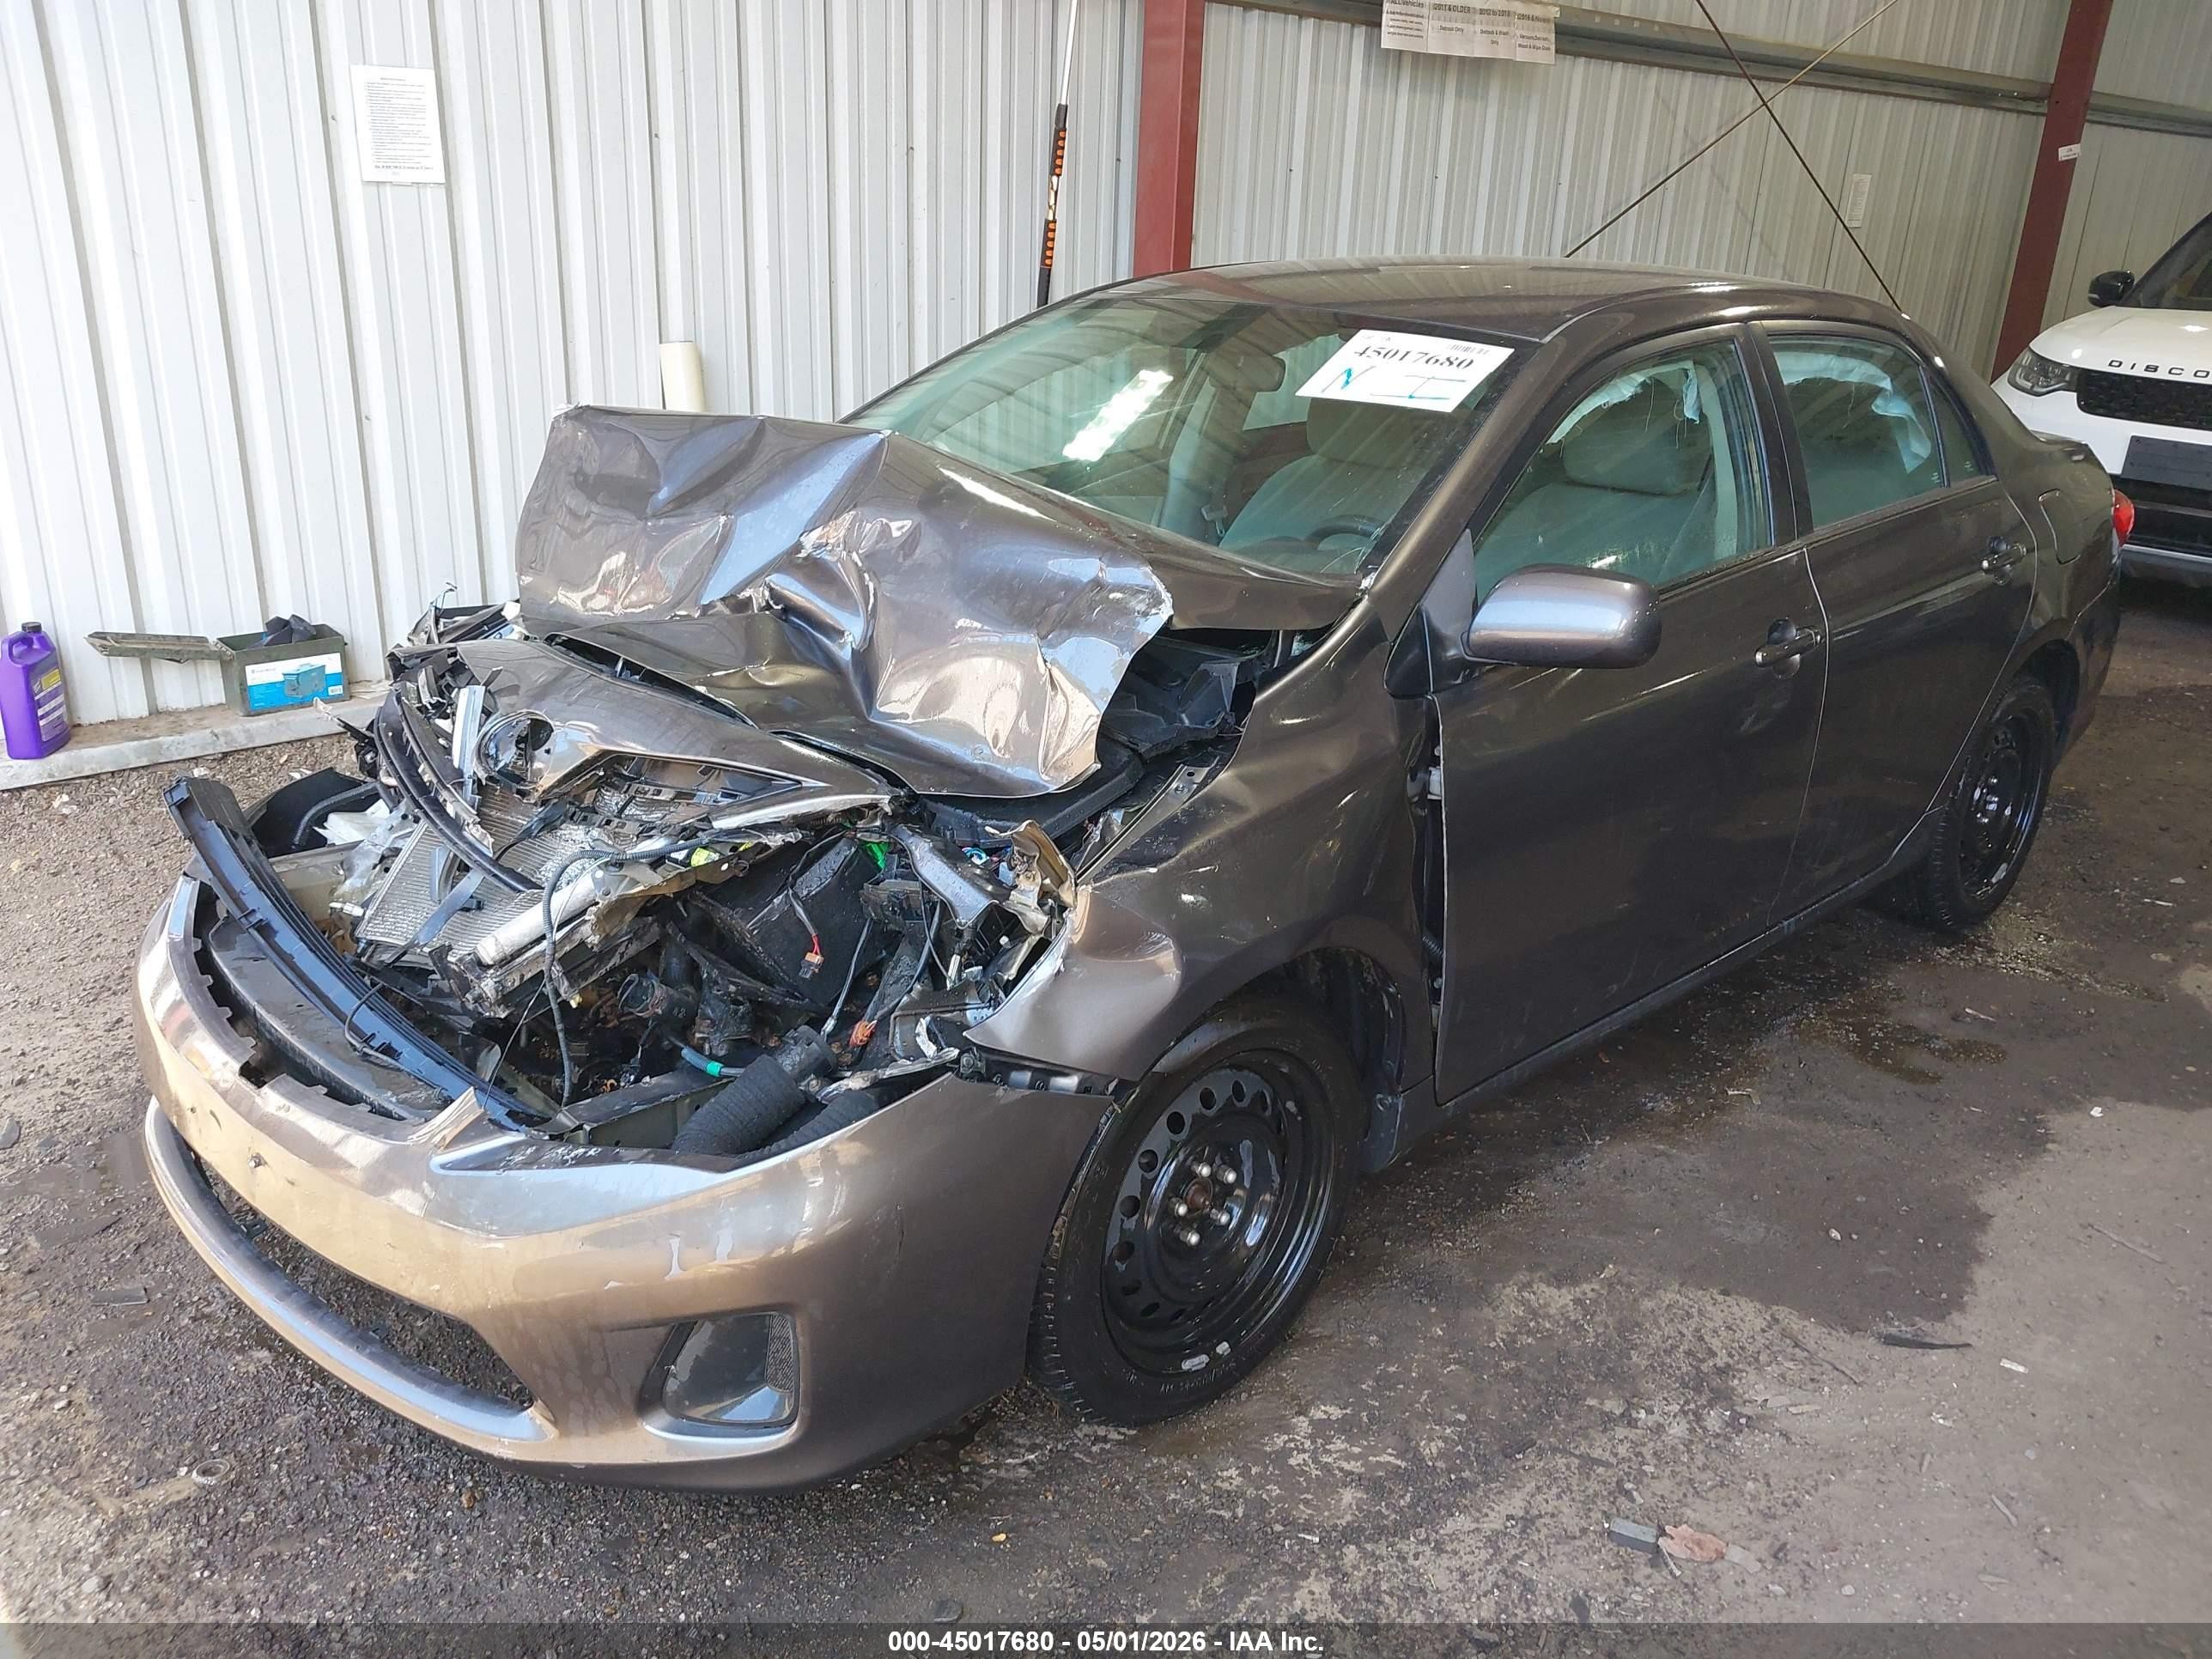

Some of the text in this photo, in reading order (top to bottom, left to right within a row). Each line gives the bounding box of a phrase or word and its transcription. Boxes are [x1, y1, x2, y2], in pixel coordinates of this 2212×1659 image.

[1452, 5, 1471, 14] OLDER
[1354, 345, 1474, 369] 45017680
[2108, 359, 2211, 379] DISCO
